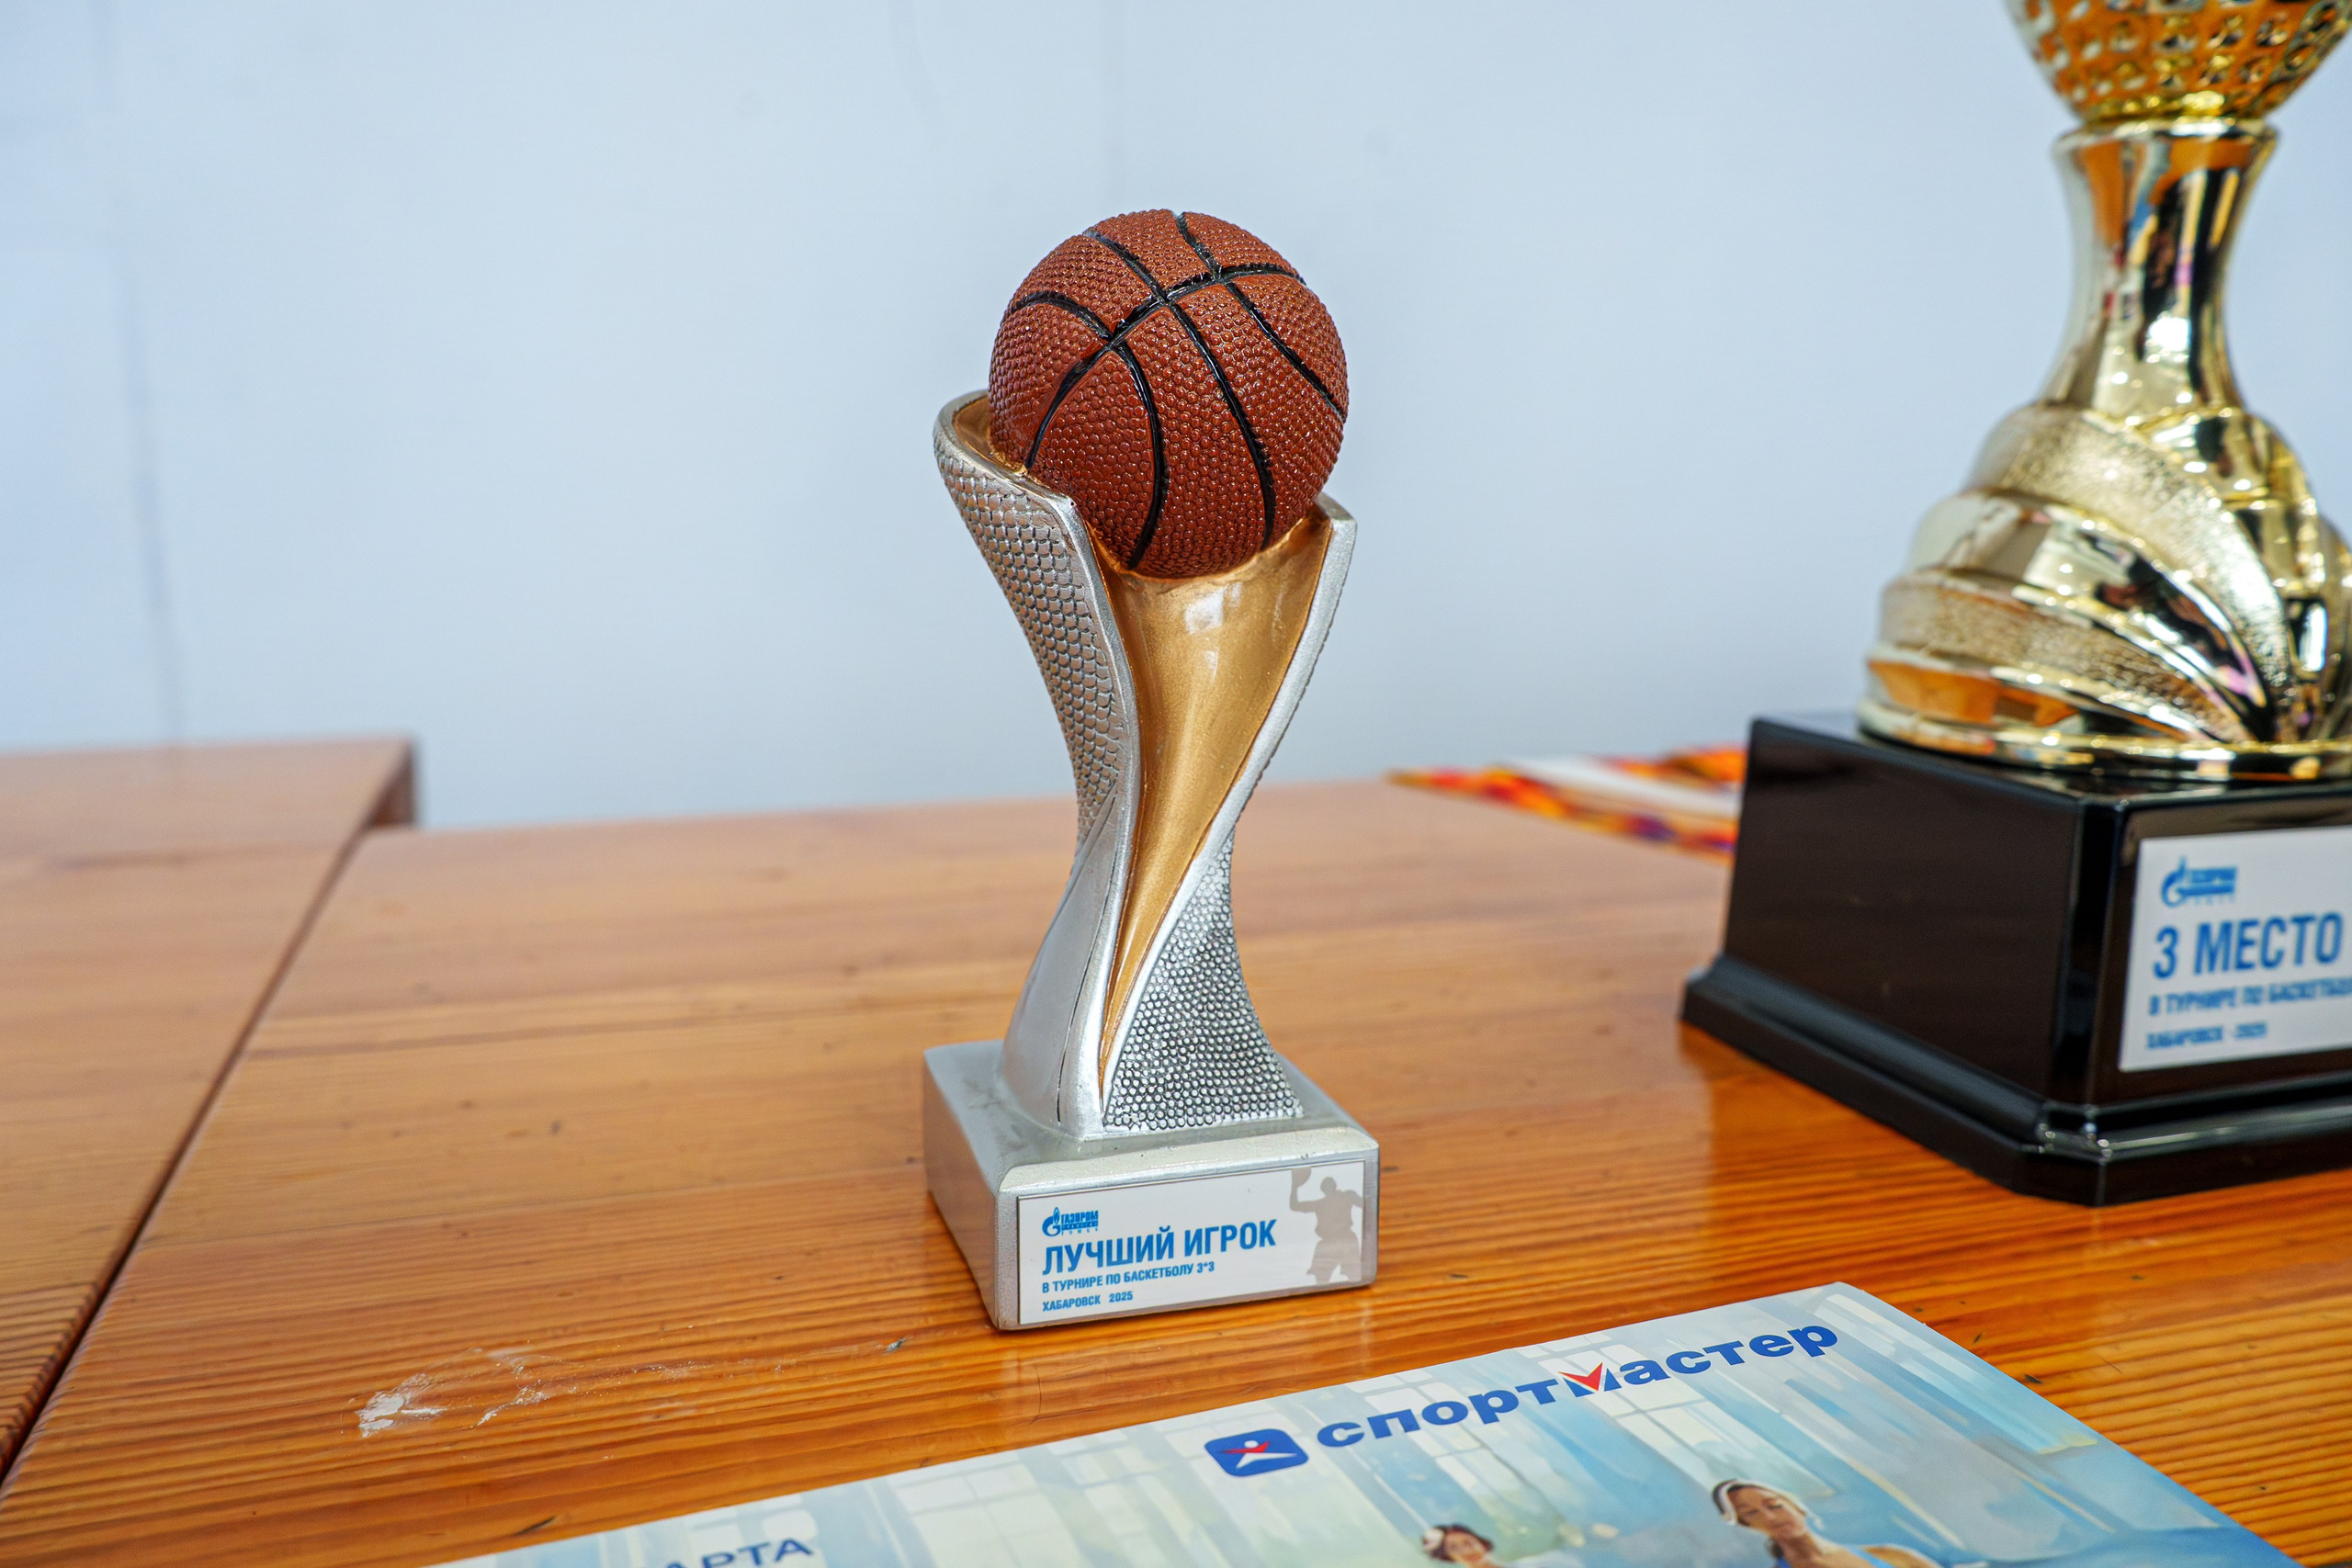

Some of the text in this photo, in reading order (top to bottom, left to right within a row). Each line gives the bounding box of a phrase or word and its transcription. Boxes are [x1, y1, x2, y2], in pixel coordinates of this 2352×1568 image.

[2153, 913, 2342, 979] 3 МЕСТО
[1060, 1211, 1099, 1224] ГАЗПРОМ
[1042, 1219, 1277, 1275] ЛУЧШИЙ ИГРОК
[1042, 1282, 1049, 1293] В
[1053, 1276, 1102, 1292] ТУРНИРЕ
[1106, 1273, 1121, 1285] ПО
[1124, 1263, 1194, 1282] БАСКЕТБОЛУ
[1043, 1291, 1133, 1312] ХАБАРОВСК 2025
